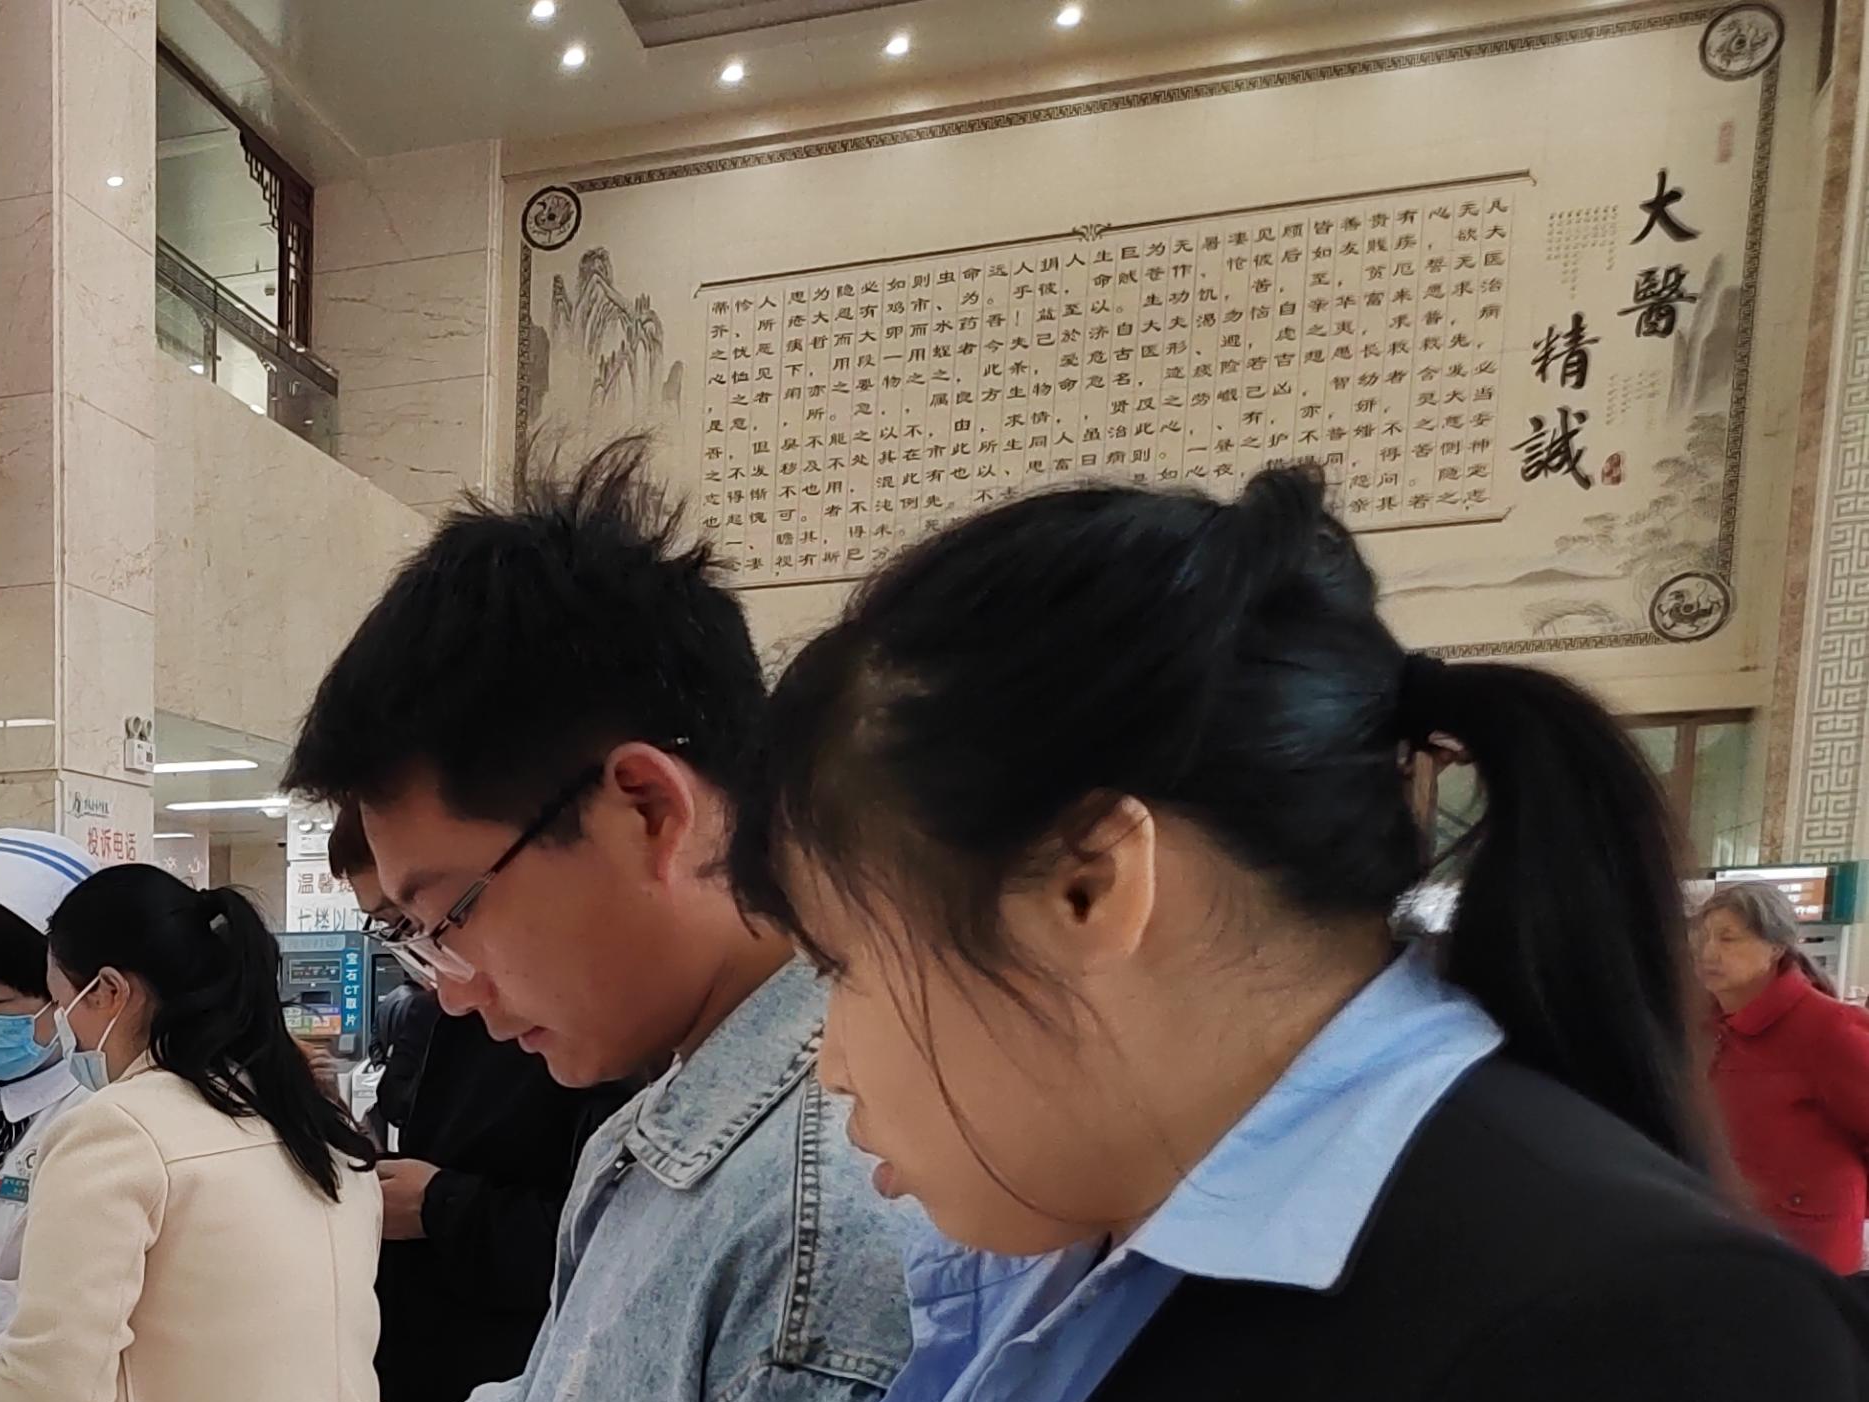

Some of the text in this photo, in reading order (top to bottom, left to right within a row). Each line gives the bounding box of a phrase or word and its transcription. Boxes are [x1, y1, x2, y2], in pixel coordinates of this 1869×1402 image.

[1511, 310, 1603, 491] 精誠
[87, 826, 137, 861] 投诉电话
